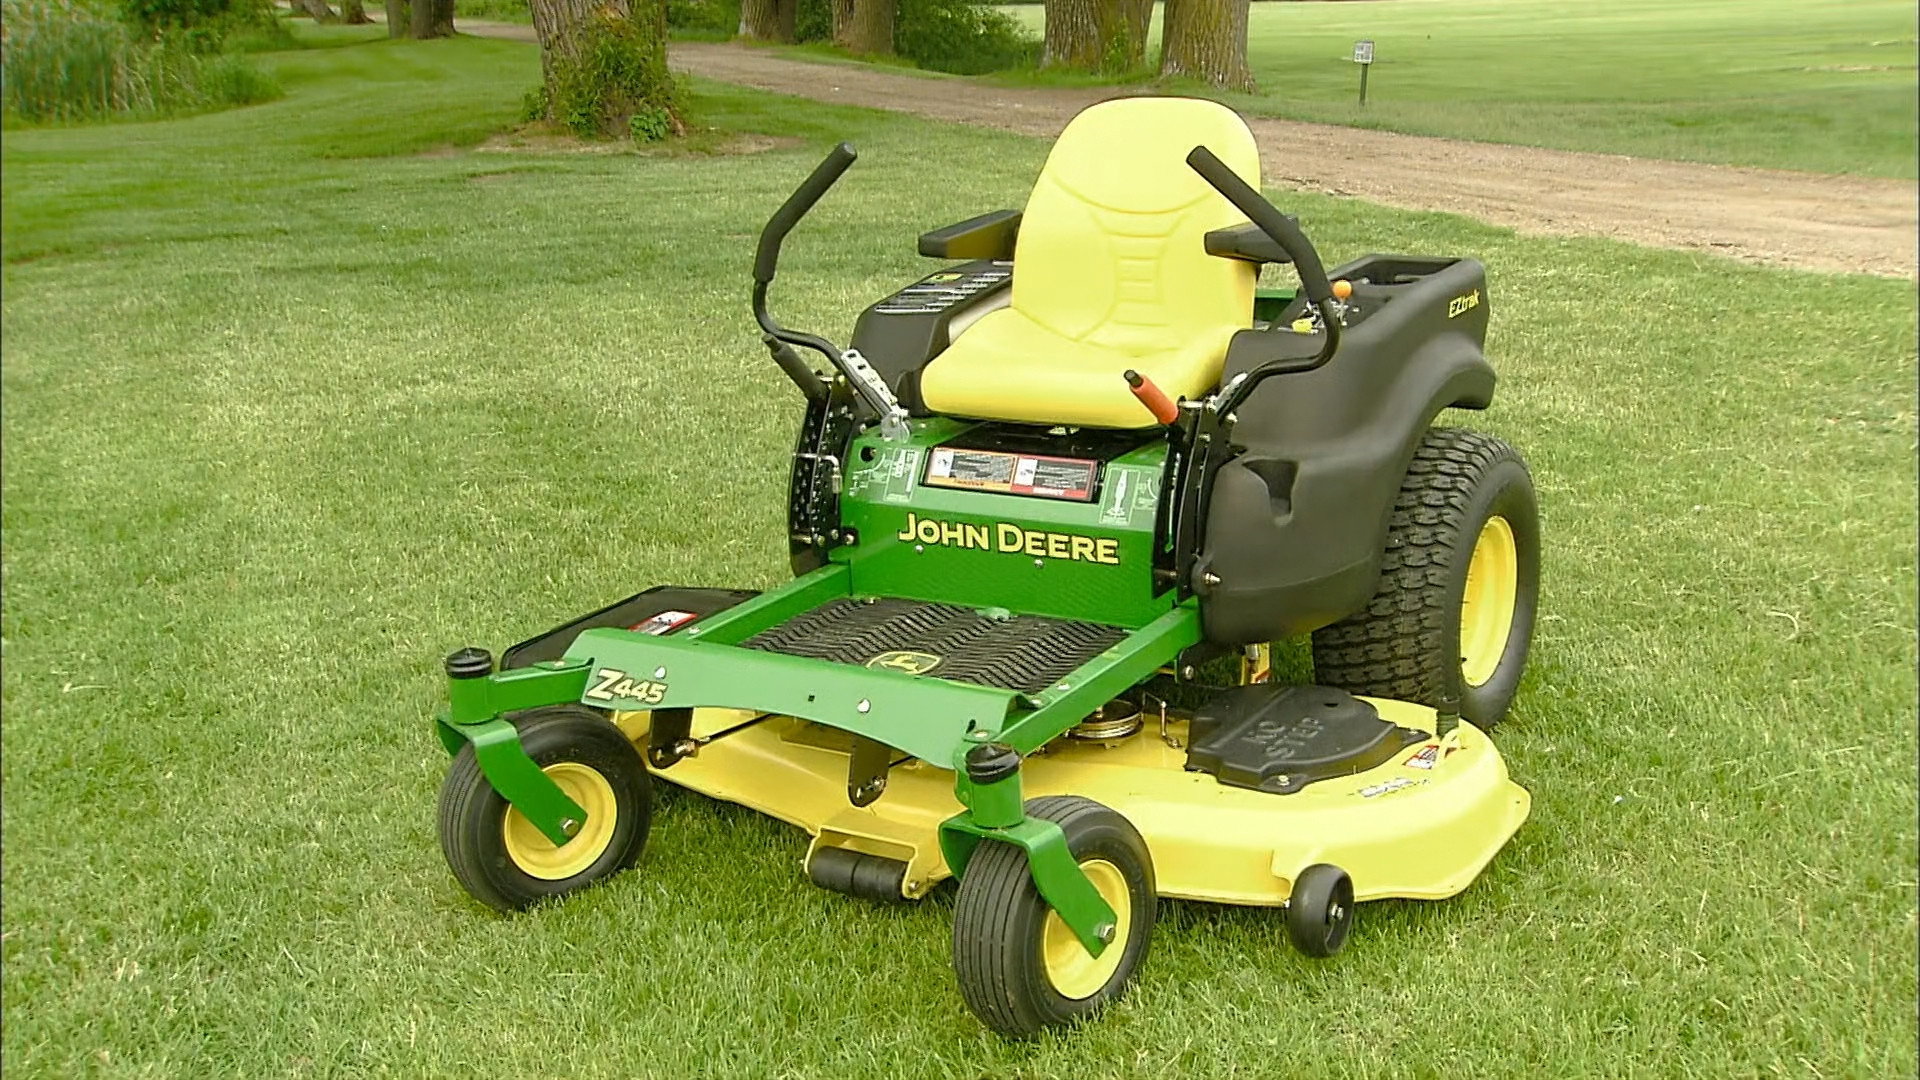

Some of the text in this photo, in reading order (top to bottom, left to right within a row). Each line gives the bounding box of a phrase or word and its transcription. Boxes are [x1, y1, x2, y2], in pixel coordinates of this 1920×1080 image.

[1448, 289, 1480, 319] EZtrak
[898, 512, 1120, 565] JOHN DEERE
[586, 667, 668, 705] Z445
